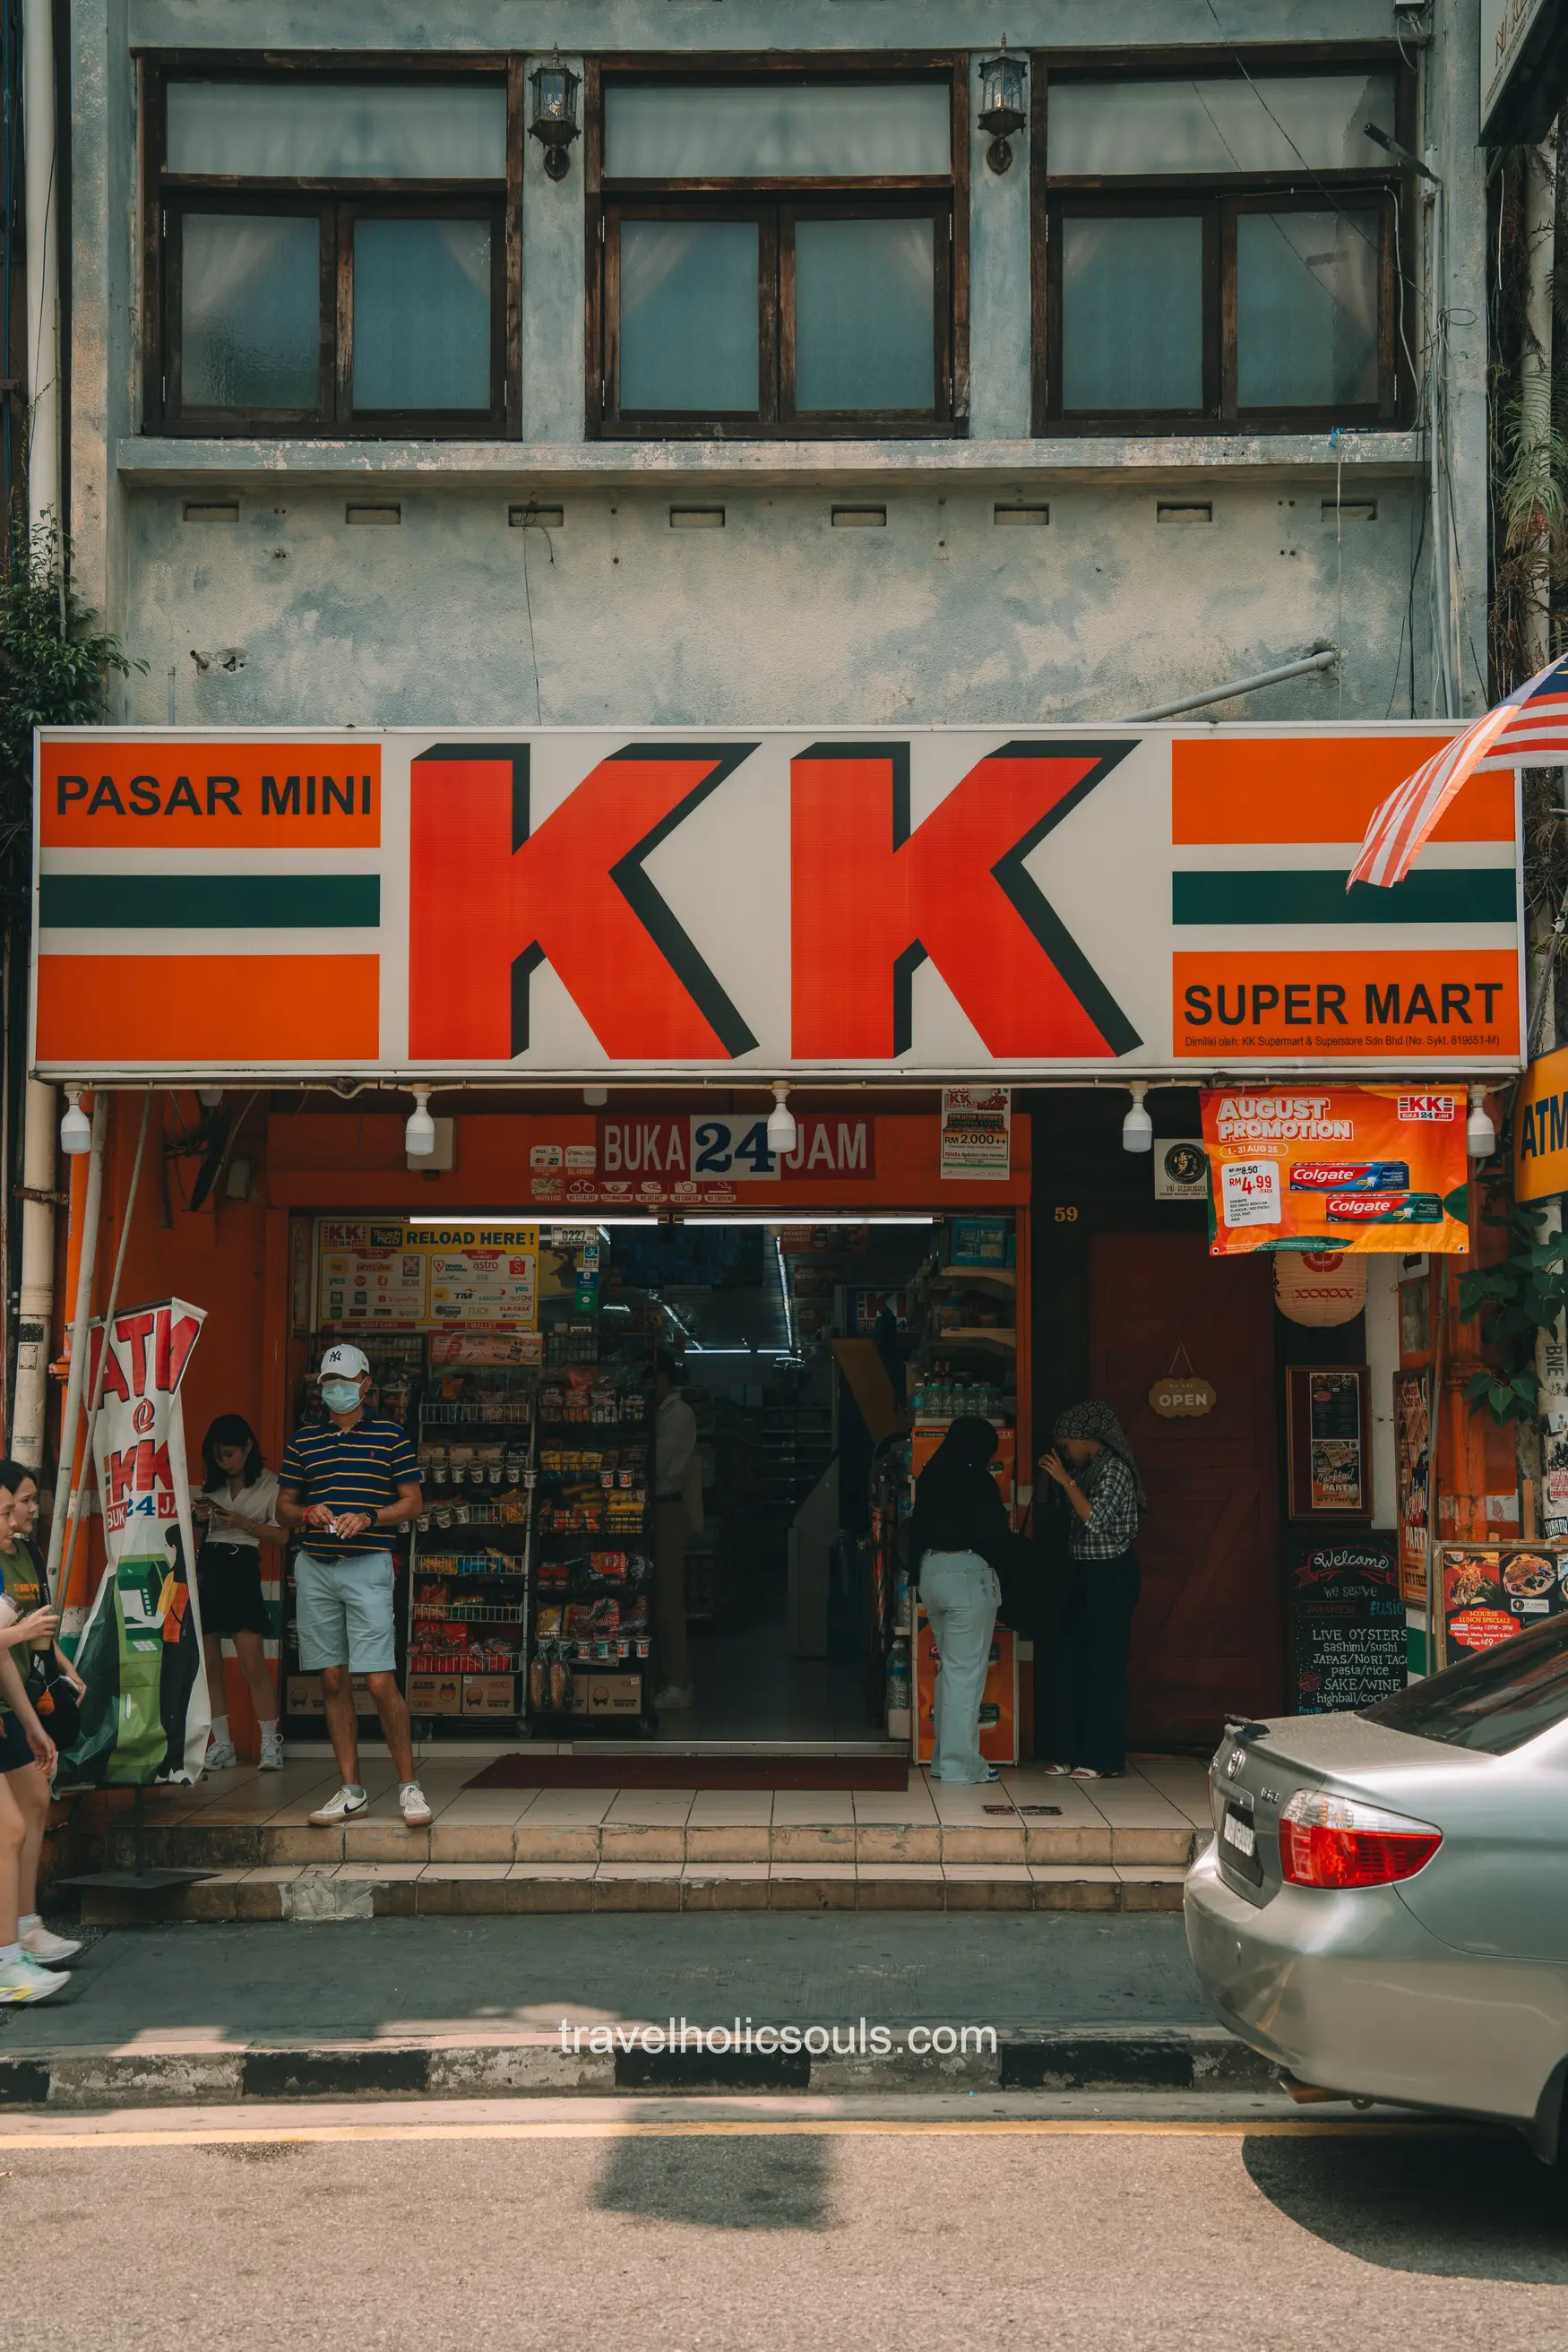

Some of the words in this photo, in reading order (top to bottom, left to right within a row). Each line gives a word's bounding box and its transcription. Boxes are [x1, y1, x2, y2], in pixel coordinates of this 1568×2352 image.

[56, 775, 242, 815] PASAR
[261, 775, 371, 815] MINI
[409, 740, 1143, 1060] KK
[1184, 984, 1348, 1025] SUPER
[1365, 983, 1503, 1024] MART
[1185, 1037, 1217, 1047] Dimiliki
[1219, 1037, 1240, 1047] oleh:
[1242, 1037, 1255, 1046] KK
[1257, 1036, 1304, 1047] Supermart
[1305, 1037, 1313, 1046] &
[1314, 1036, 1363, 1047] Superstore
[1365, 1036, 1383, 1046] Sdn
[1385, 1036, 1403, 1046] Bhd
[1405, 1036, 1424, 1047] (No.
[1426, 1036, 1449, 1047] Sykt.
[1217, 1098, 1331, 1121] AUGUST
[1409, 1097, 1443, 1112] KK
[1420, 1111, 1434, 1119] 24
[1219, 1120, 1352, 1141] PROMOTION
[1520, 1090, 1568, 1161] ATM
[604, 1124, 686, 1171] BUKA
[694, 1122, 776, 1173] 24
[785, 1123, 866, 1169] JAM
[1247, 1146, 1266, 1154] AUG
[1293, 1168, 1354, 1184] Colgate
[1054, 1206, 1079, 1222] 59
[1329, 1201, 1391, 1214] Colgate
[406, 1231, 475, 1245] RELOAD
[472, 1261, 499, 1270] astro
[328, 1277, 346, 1287] yes
[453, 1292, 473, 1300] TM
[514, 1286, 529, 1294] yes
[464, 1322, 497, 1330] E-WALLET
[1546, 1344, 1564, 1378] BNE
[1159, 1393, 1208, 1407] OPEN
[1316, 1468, 1356, 1486] Cocktail
[1322, 1484, 1357, 1492] PARTY!
[1314, 1550, 1389, 1569] Welcome
[1306, 1604, 1357, 1615] JAPANESE
[1313, 1630, 1342, 1641] LIVE
[1348, 1630, 1408, 1641] OYSTERS
[1331, 1665, 1389, 1677] pasta/rice
[1324, 1678, 1401, 1692] SAKE/WINE
